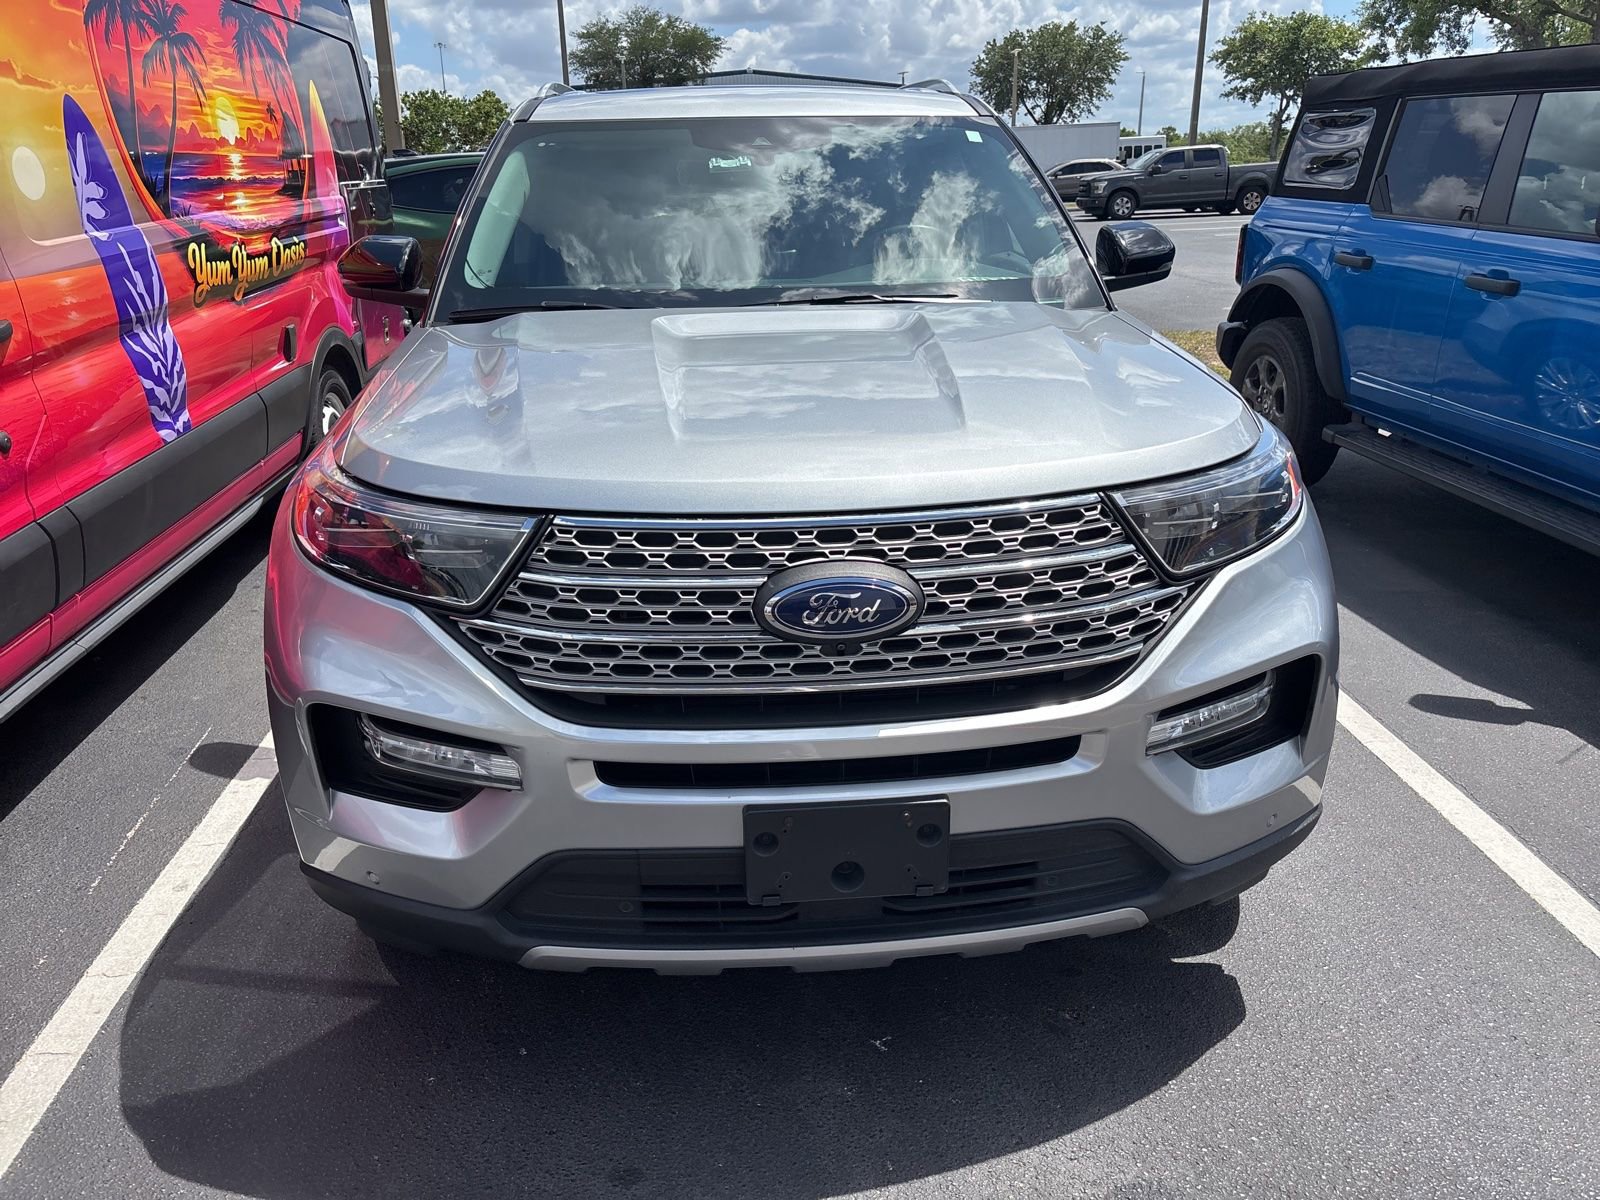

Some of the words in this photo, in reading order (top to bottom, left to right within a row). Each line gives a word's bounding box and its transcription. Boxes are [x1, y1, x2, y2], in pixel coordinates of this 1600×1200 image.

[187, 242, 233, 304] Yum
[231, 241, 269, 301] Yum
[270, 236, 305, 276] Oasis
[802, 592, 882, 627] Ford
